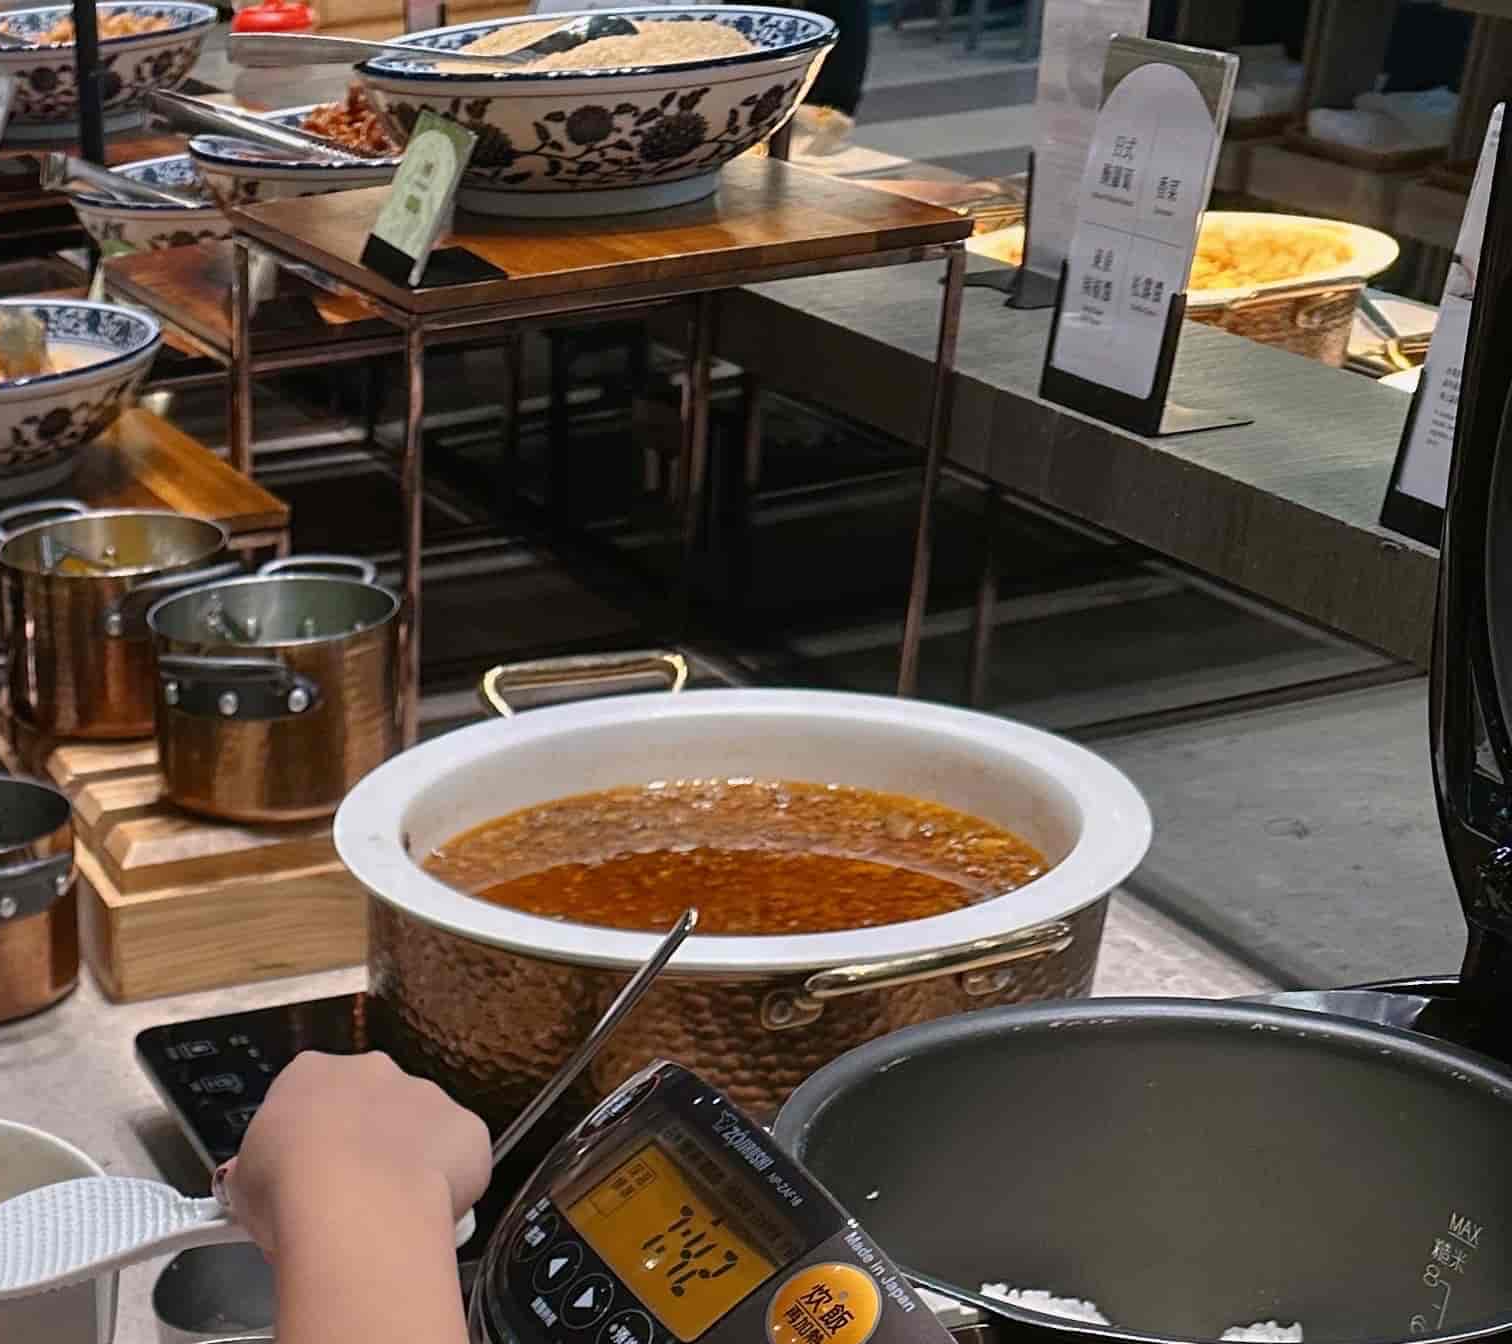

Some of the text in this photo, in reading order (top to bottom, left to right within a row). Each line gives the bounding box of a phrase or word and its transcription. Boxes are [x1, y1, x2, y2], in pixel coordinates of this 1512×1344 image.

[1449, 1212, 1483, 1245] MAX
[843, 1231, 875, 1263] Made
[880, 1275, 916, 1313] Japan
[1423, 1264, 1440, 1288] 8
[799, 1283, 856, 1335] 炊飯
